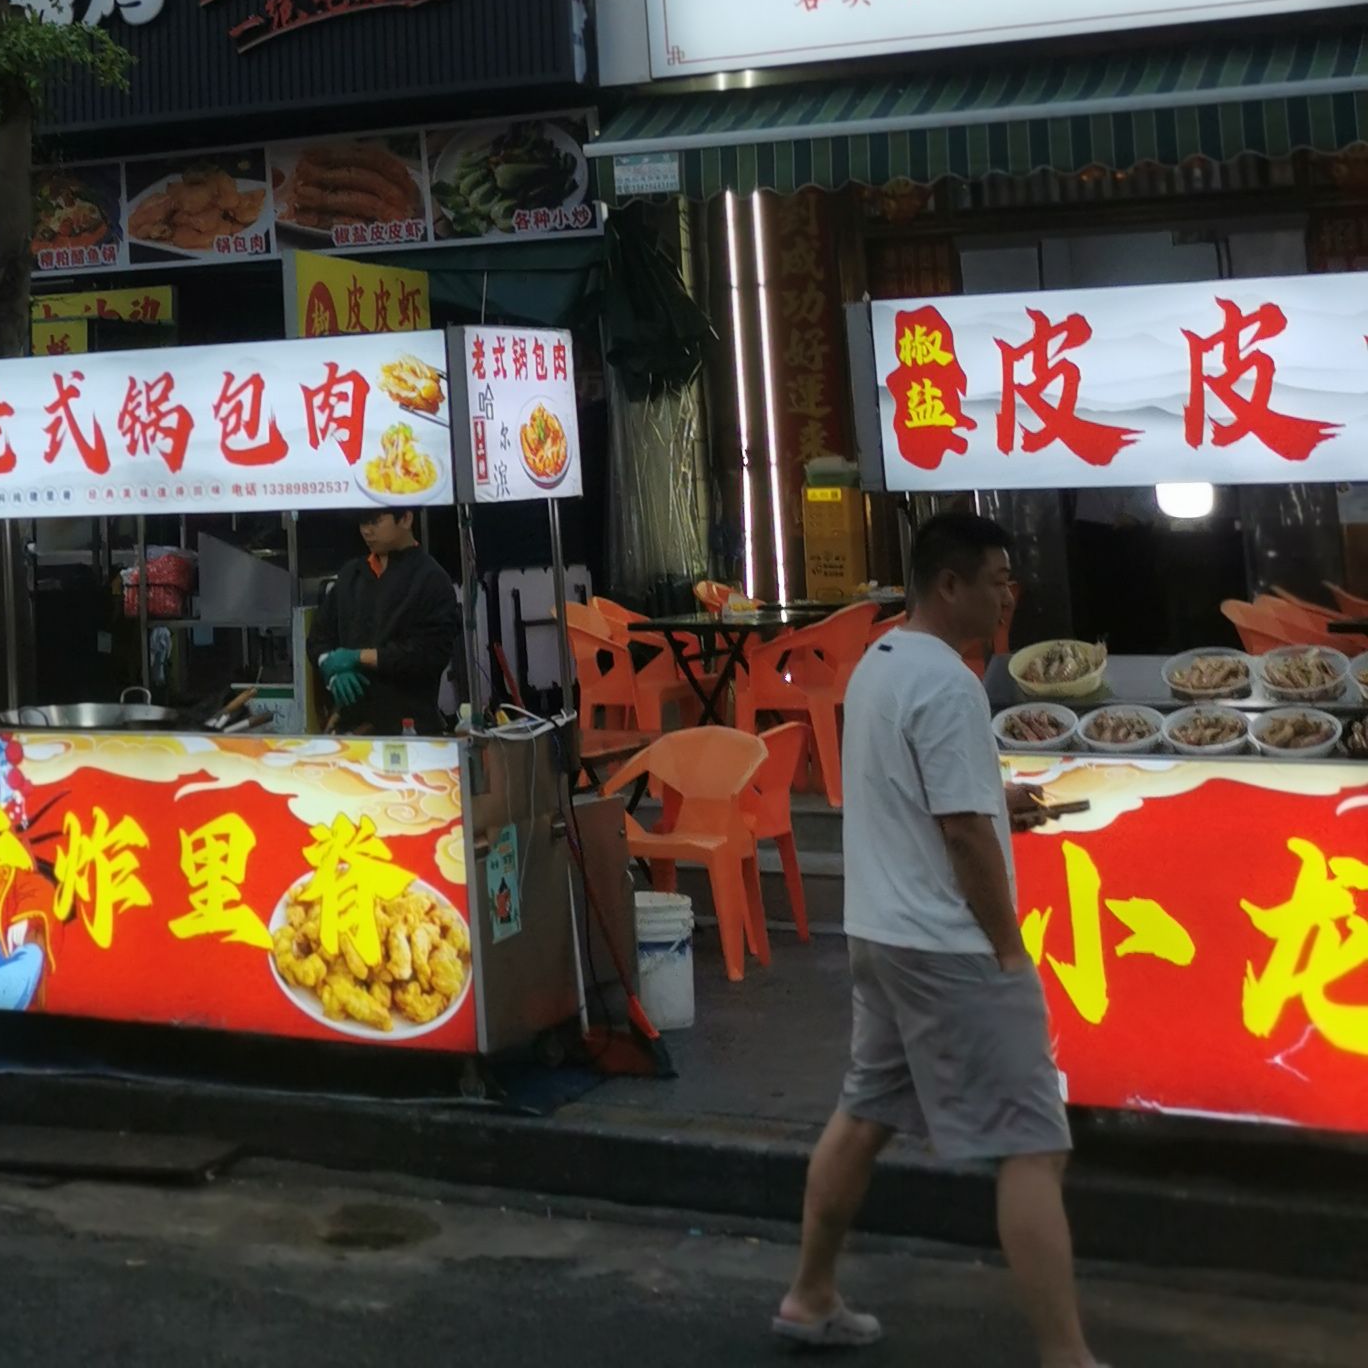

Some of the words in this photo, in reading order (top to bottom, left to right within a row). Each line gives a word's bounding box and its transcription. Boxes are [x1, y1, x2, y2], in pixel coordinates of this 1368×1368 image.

[333, 220, 424, 247] 椒盐皮皮虾
[513, 205, 593, 231] 各种小炒
[213, 235, 266, 254] 锅包肉
[346, 275, 422, 334] 皮皮虾
[472, 334, 567, 382] 老式锅包肉
[898, 325, 958, 428] 椒盐
[993, 296, 1346, 467] 皮皮
[231, 482, 257, 497] 电话
[262, 480, 349, 496] 13389892537
